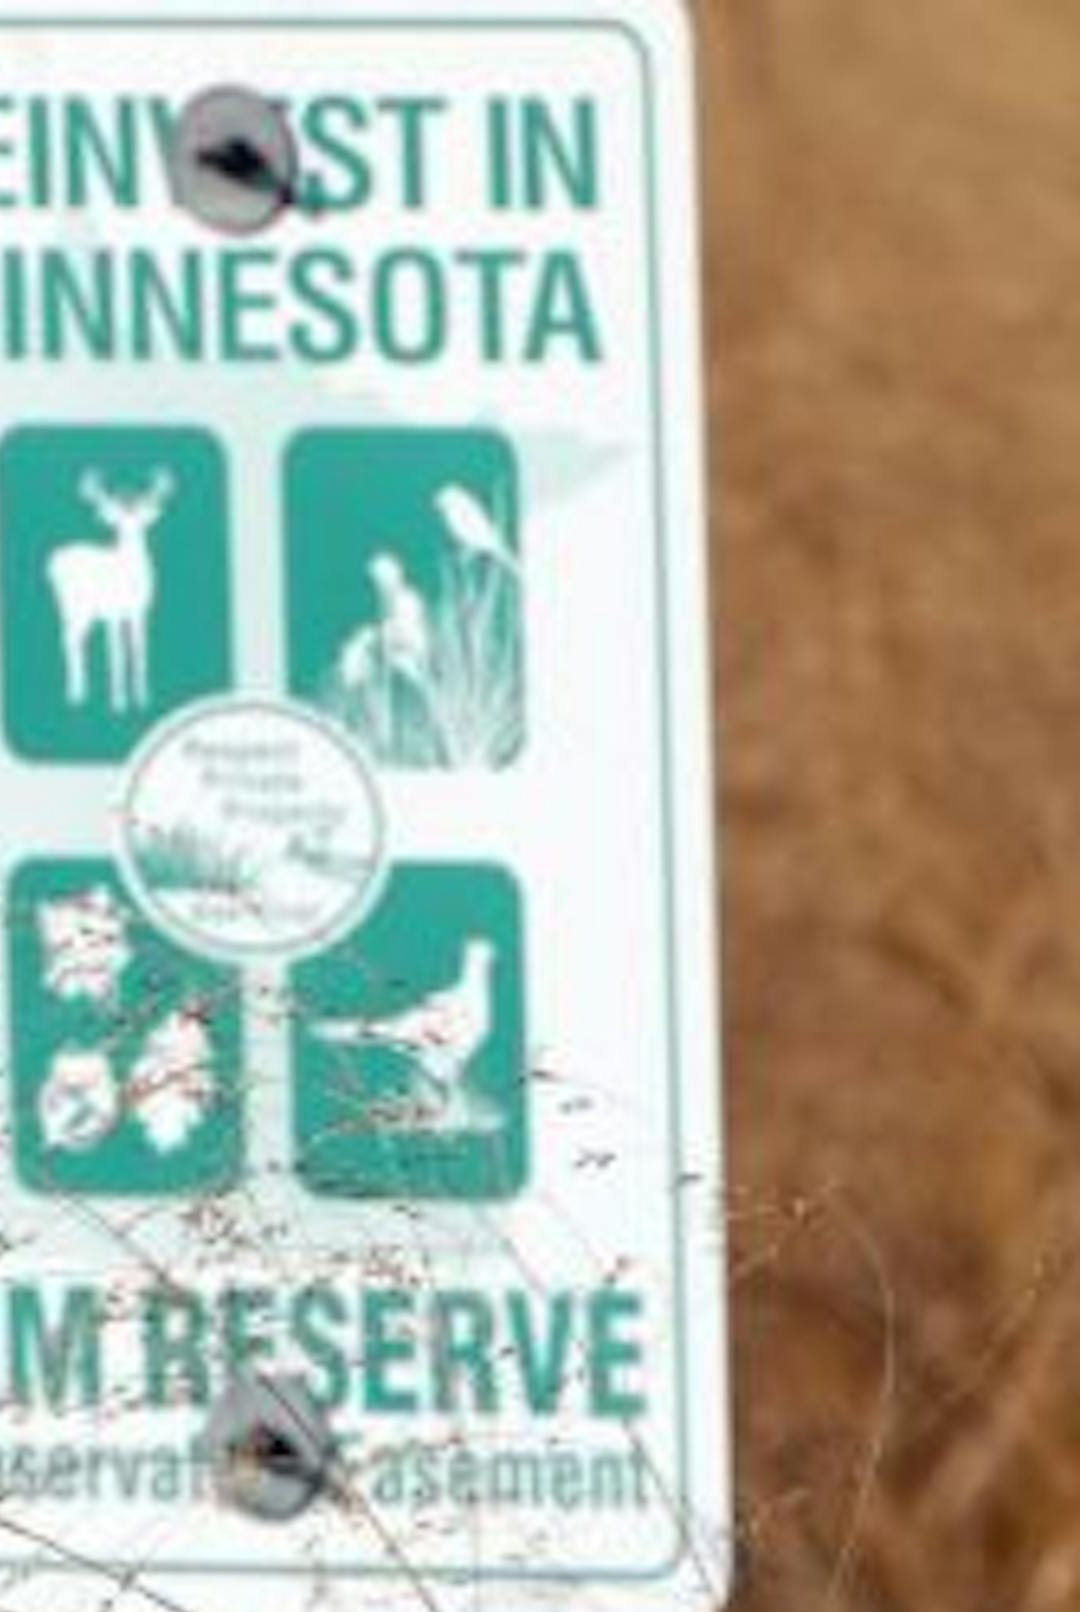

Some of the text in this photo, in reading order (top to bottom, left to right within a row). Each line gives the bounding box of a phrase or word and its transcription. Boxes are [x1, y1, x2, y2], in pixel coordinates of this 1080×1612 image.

[486, 94, 599, 211] IN
[140, 1286, 647, 1418] RESERVE
[324, 1430, 647, 1508] asement
